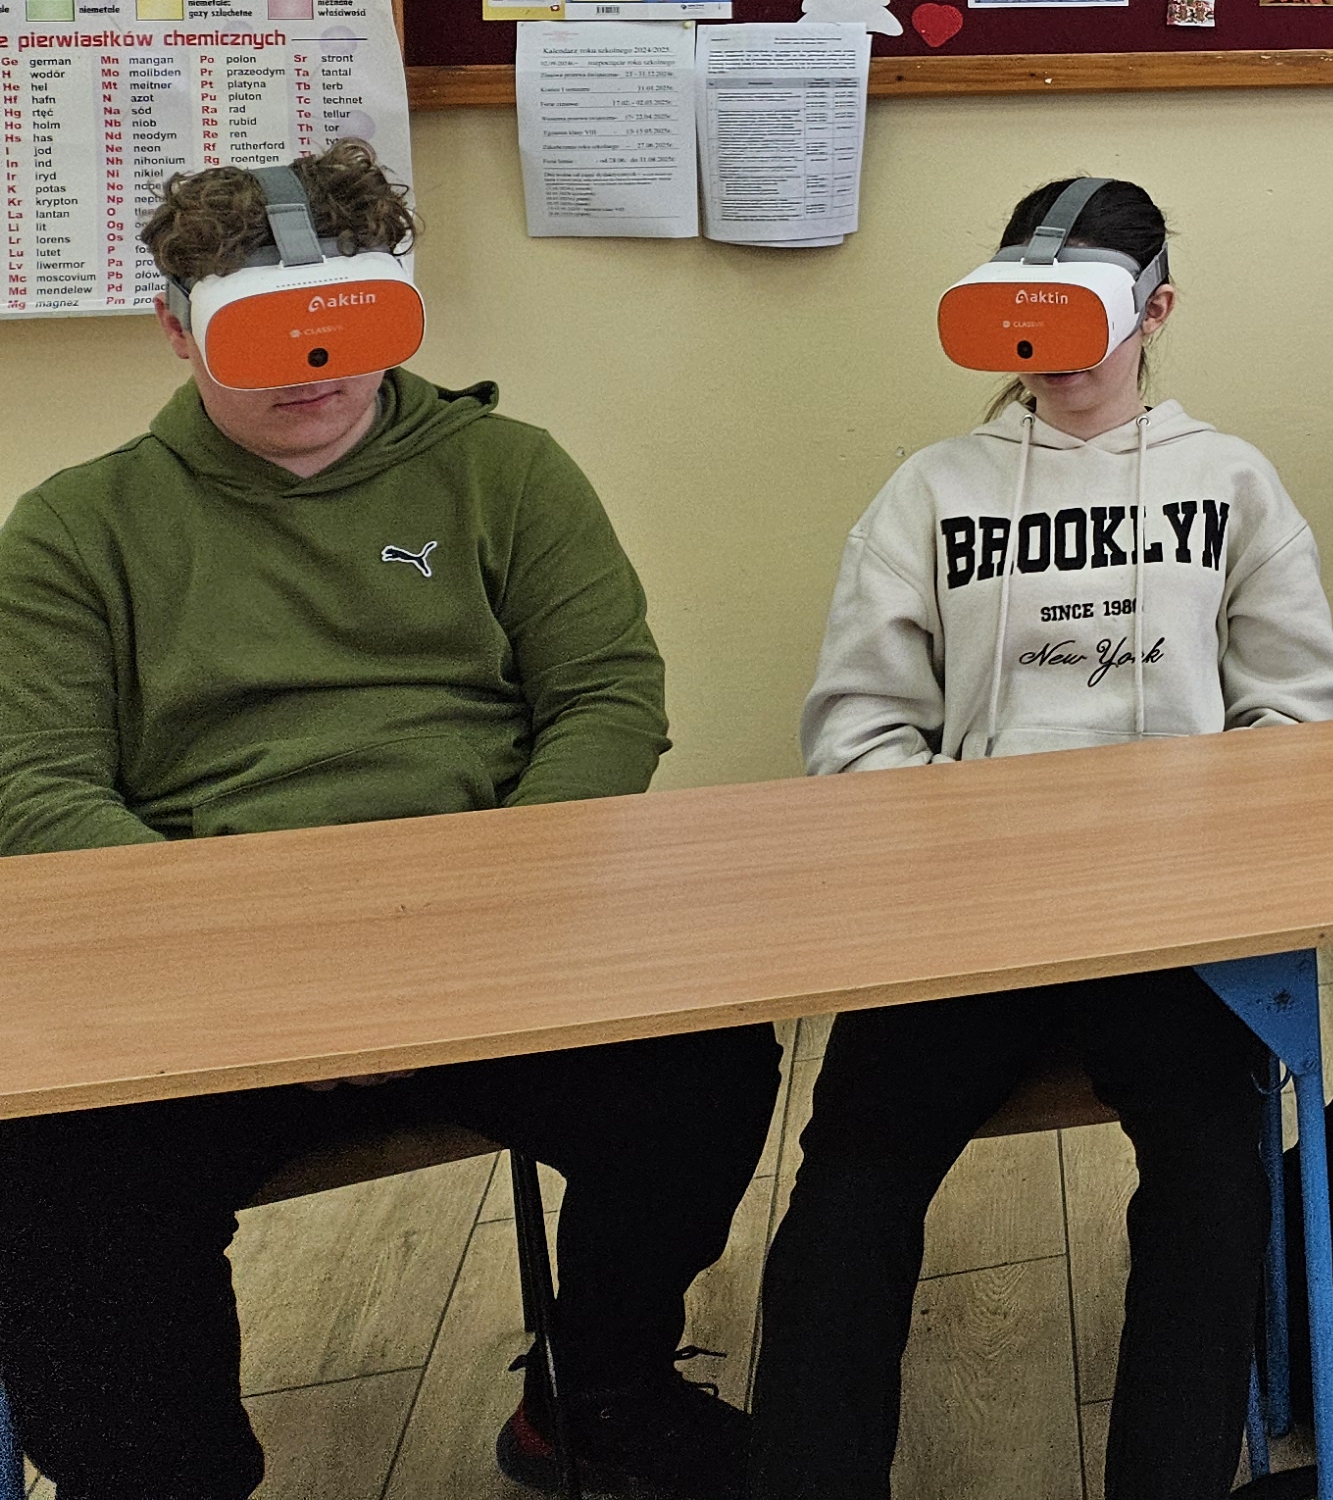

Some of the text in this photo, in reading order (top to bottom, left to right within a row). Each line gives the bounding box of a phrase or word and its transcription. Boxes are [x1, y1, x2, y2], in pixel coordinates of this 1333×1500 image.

[18, 29, 286, 52] pierwiastków chemicznych
[1, 57, 72, 68] Ge german
[101, 56, 174, 66] Mn mangan
[200, 54, 257, 65] Po polon
[293, 54, 354, 63] Sr stront
[2, 69, 66, 79] H wodór
[101, 68, 182, 77] Mo molibden
[200, 67, 286, 78] Pr prazeodym
[294, 67, 351, 77] Ta tantal
[3, 82, 48, 91] He hel
[101, 81, 173, 90] Mt meitner
[200, 80, 267, 90] Pt platyna
[3, 95, 56, 104] Hf hafn
[103, 94, 155, 103] N azot
[4, 109, 22, 119] Hg
[5, 120, 61, 130] Ho holm
[8, 272, 96, 283] Mc moscovium
[8, 285, 93, 296] Md mendelew
[327, 291, 376, 308] aktin
[1030, 290, 1069, 305] aktin
[940, 499, 1230, 589] BROOKLYN
[1040, 602, 1094, 623] SINCE
[1019, 639, 1088, 666] New
